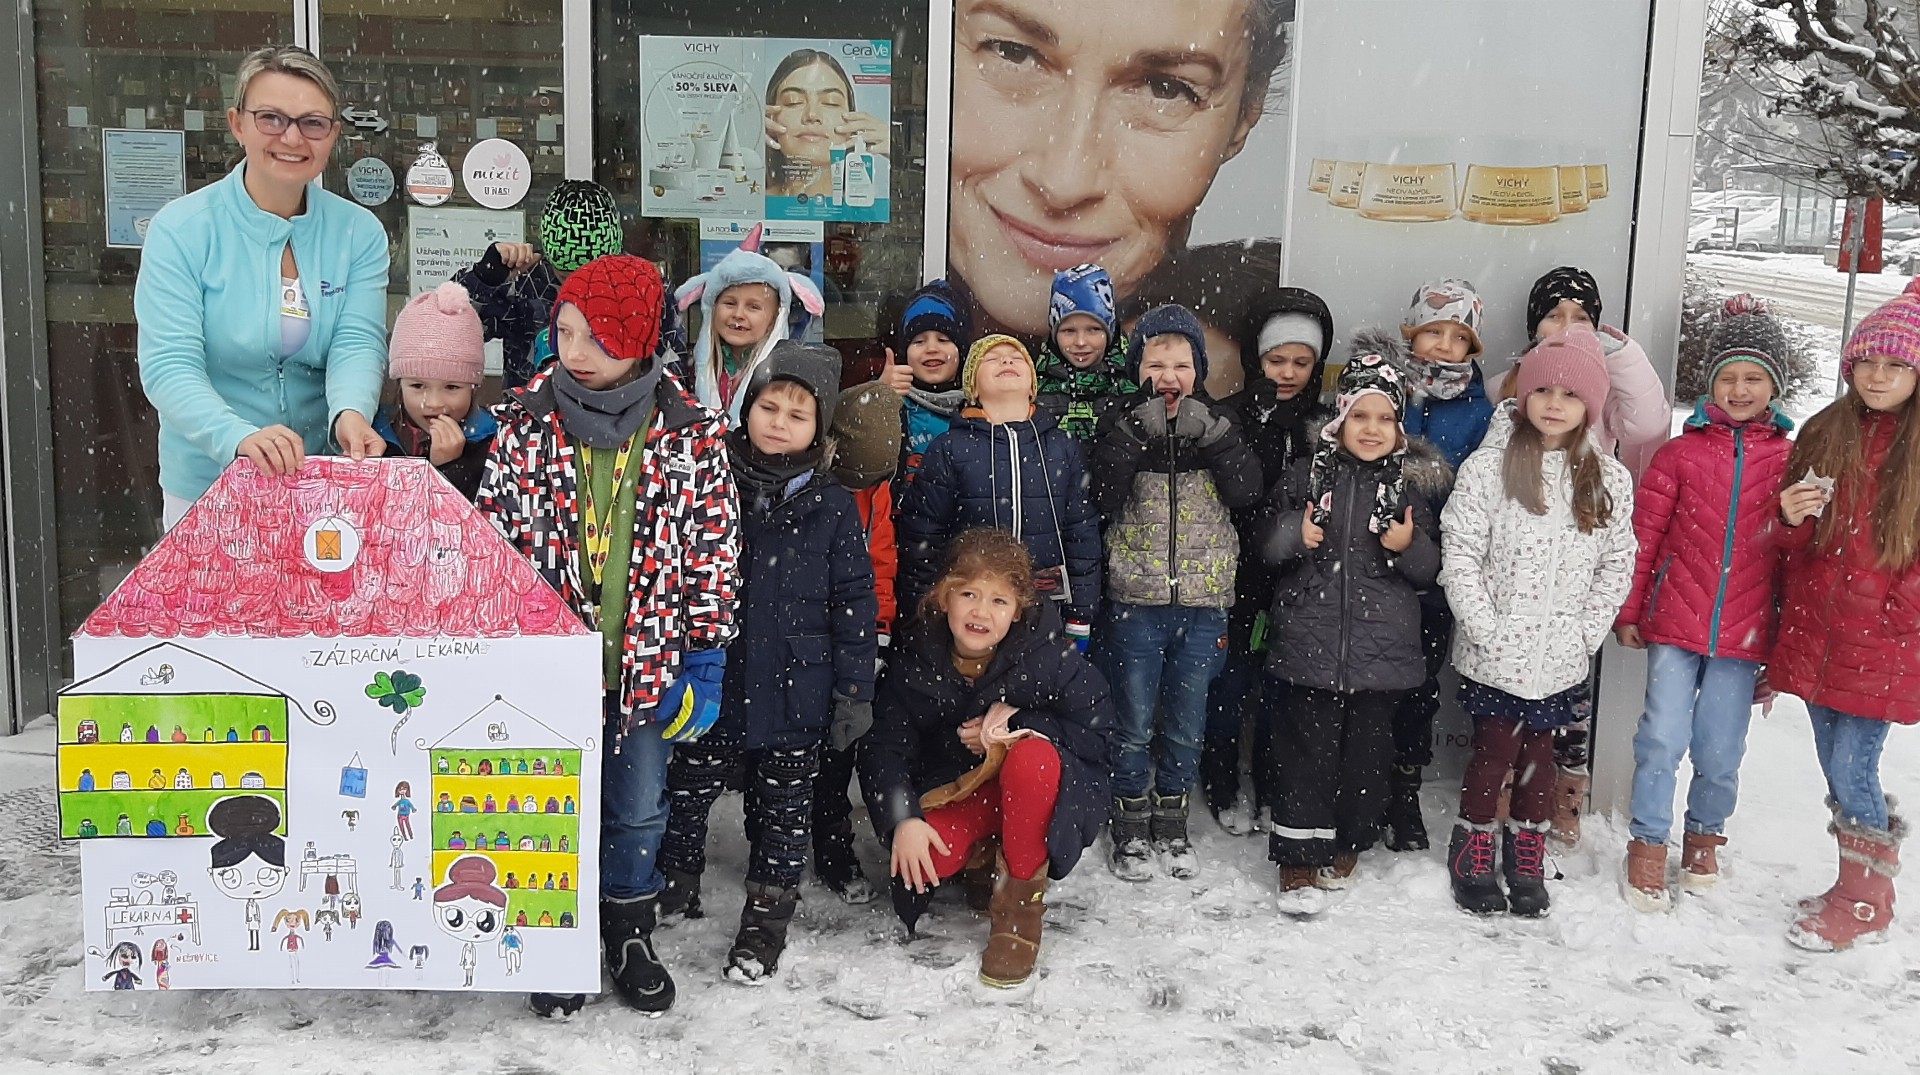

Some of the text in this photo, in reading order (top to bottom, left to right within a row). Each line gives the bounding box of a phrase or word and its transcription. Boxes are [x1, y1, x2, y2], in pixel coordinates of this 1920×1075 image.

[684, 42, 719, 54] VICHY
[842, 43, 888, 57] CeraVe
[675, 82, 700, 92] 50%
[703, 82, 738, 93] SLEVA
[358, 166, 384, 175] VICHY
[472, 167, 520, 181] mixit
[1393, 175, 1426, 185] VICHY
[1496, 178, 1530, 189] VICHY
[484, 186, 510, 196] U NÁS!
[453, 248, 486, 258] ANTIB
[310, 638, 480, 667] ZÁZRAČNÁ LÉKÁRNA
